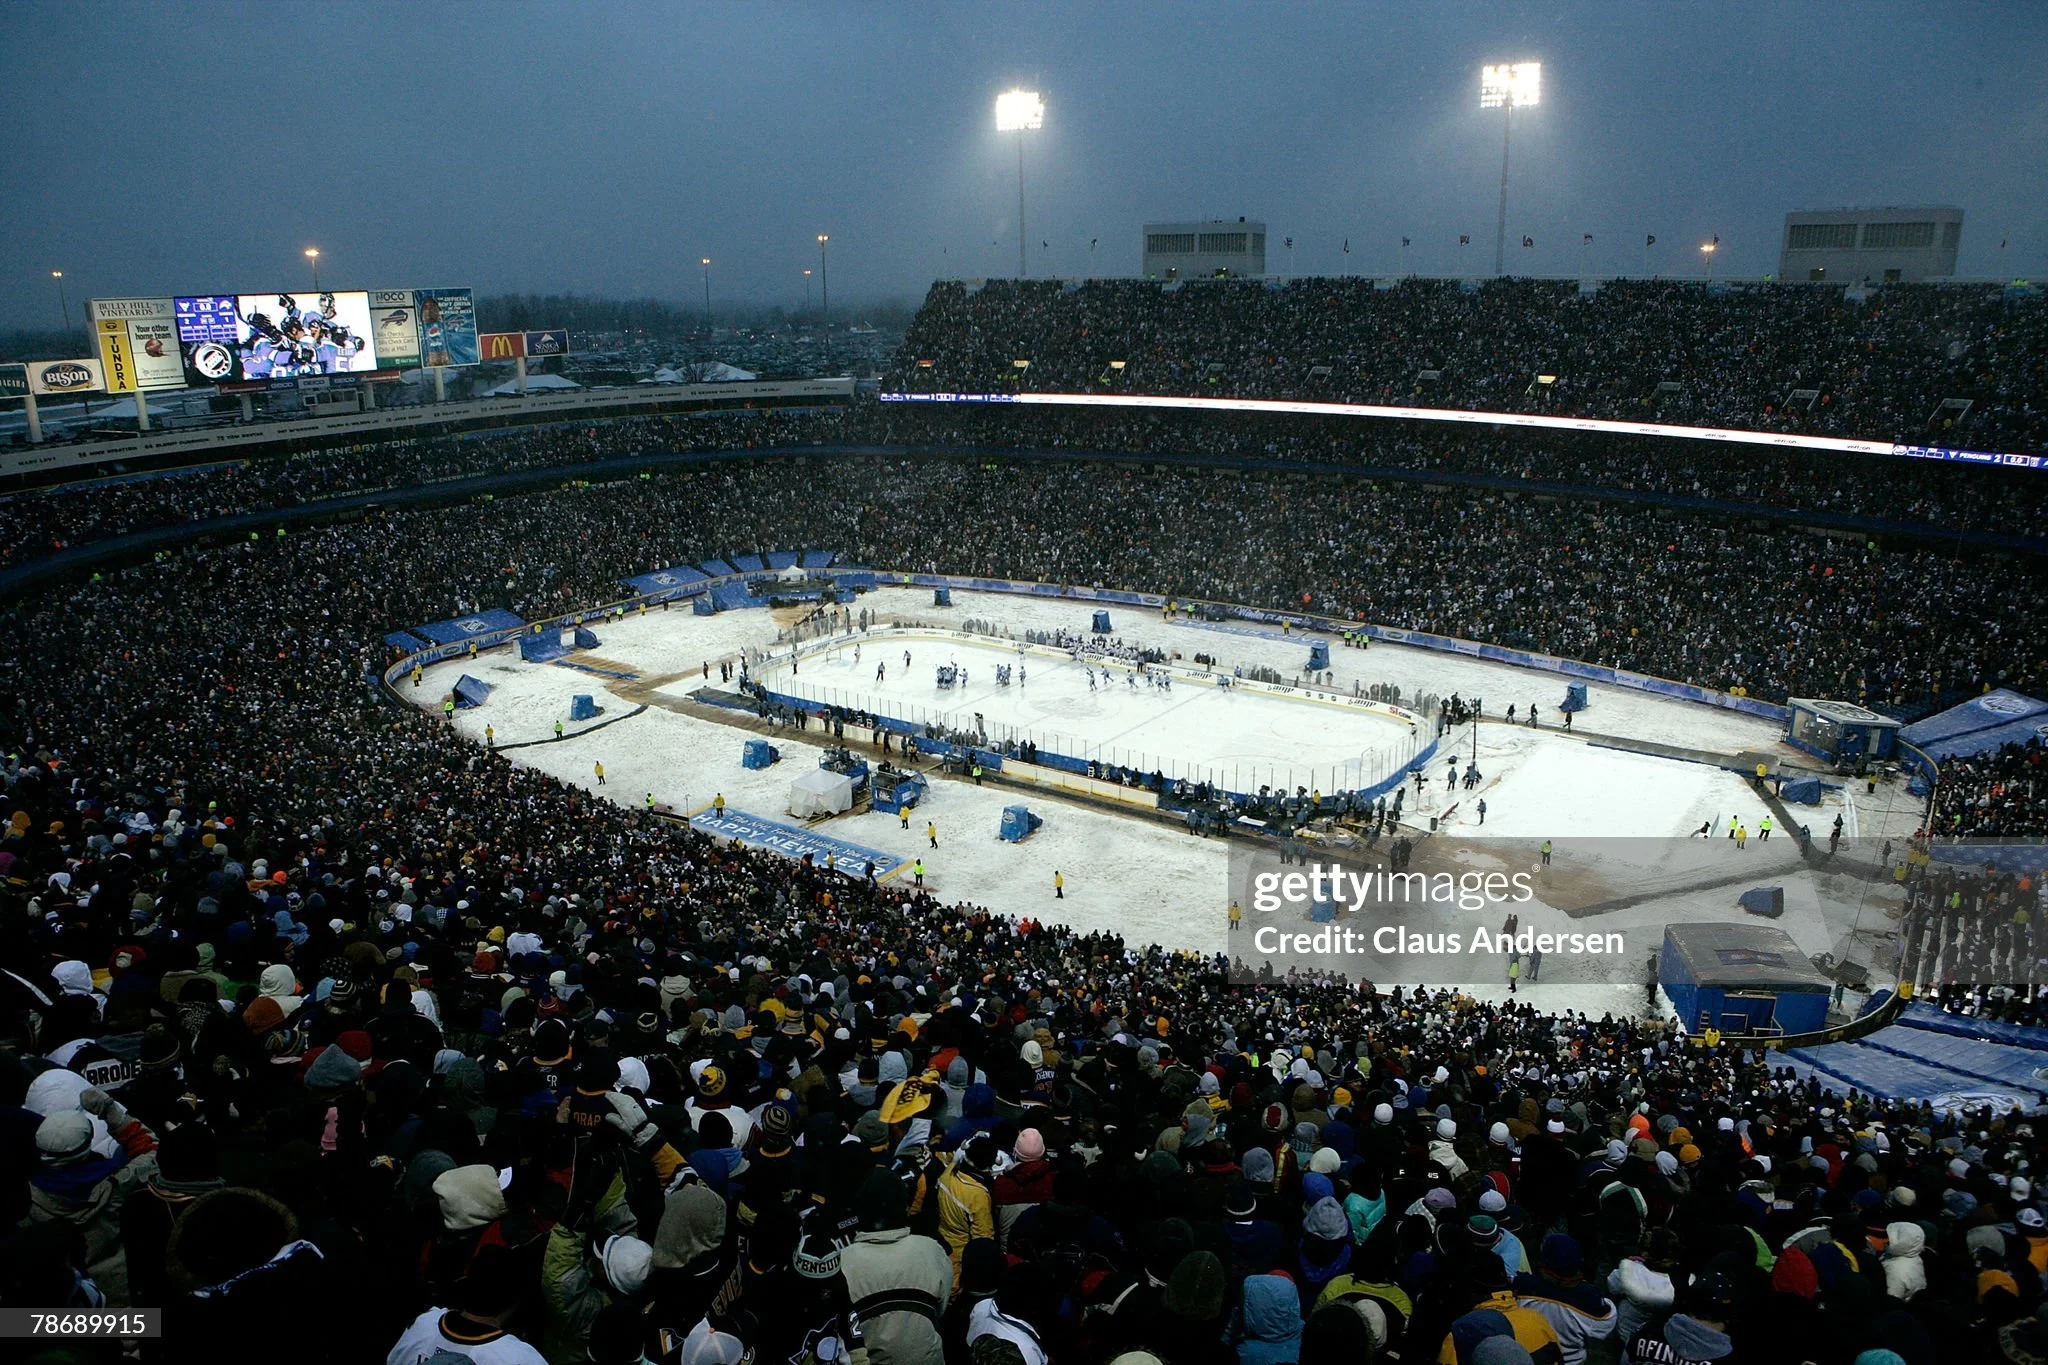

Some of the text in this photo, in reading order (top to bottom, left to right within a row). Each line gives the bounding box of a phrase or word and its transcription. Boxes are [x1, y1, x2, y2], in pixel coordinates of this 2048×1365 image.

[98, 301, 151, 310] BULLY HILL
[100, 308, 154, 317] VINEYARDS
[151, 324, 169, 332] other
[109, 335, 127, 390] TUNDRA
[326, 442, 378, 457] ENEGY
[1993, 454, 2001, 463] 2
[693, 814, 765, 838] HAPPY
[764, 835, 820, 855] NEW
